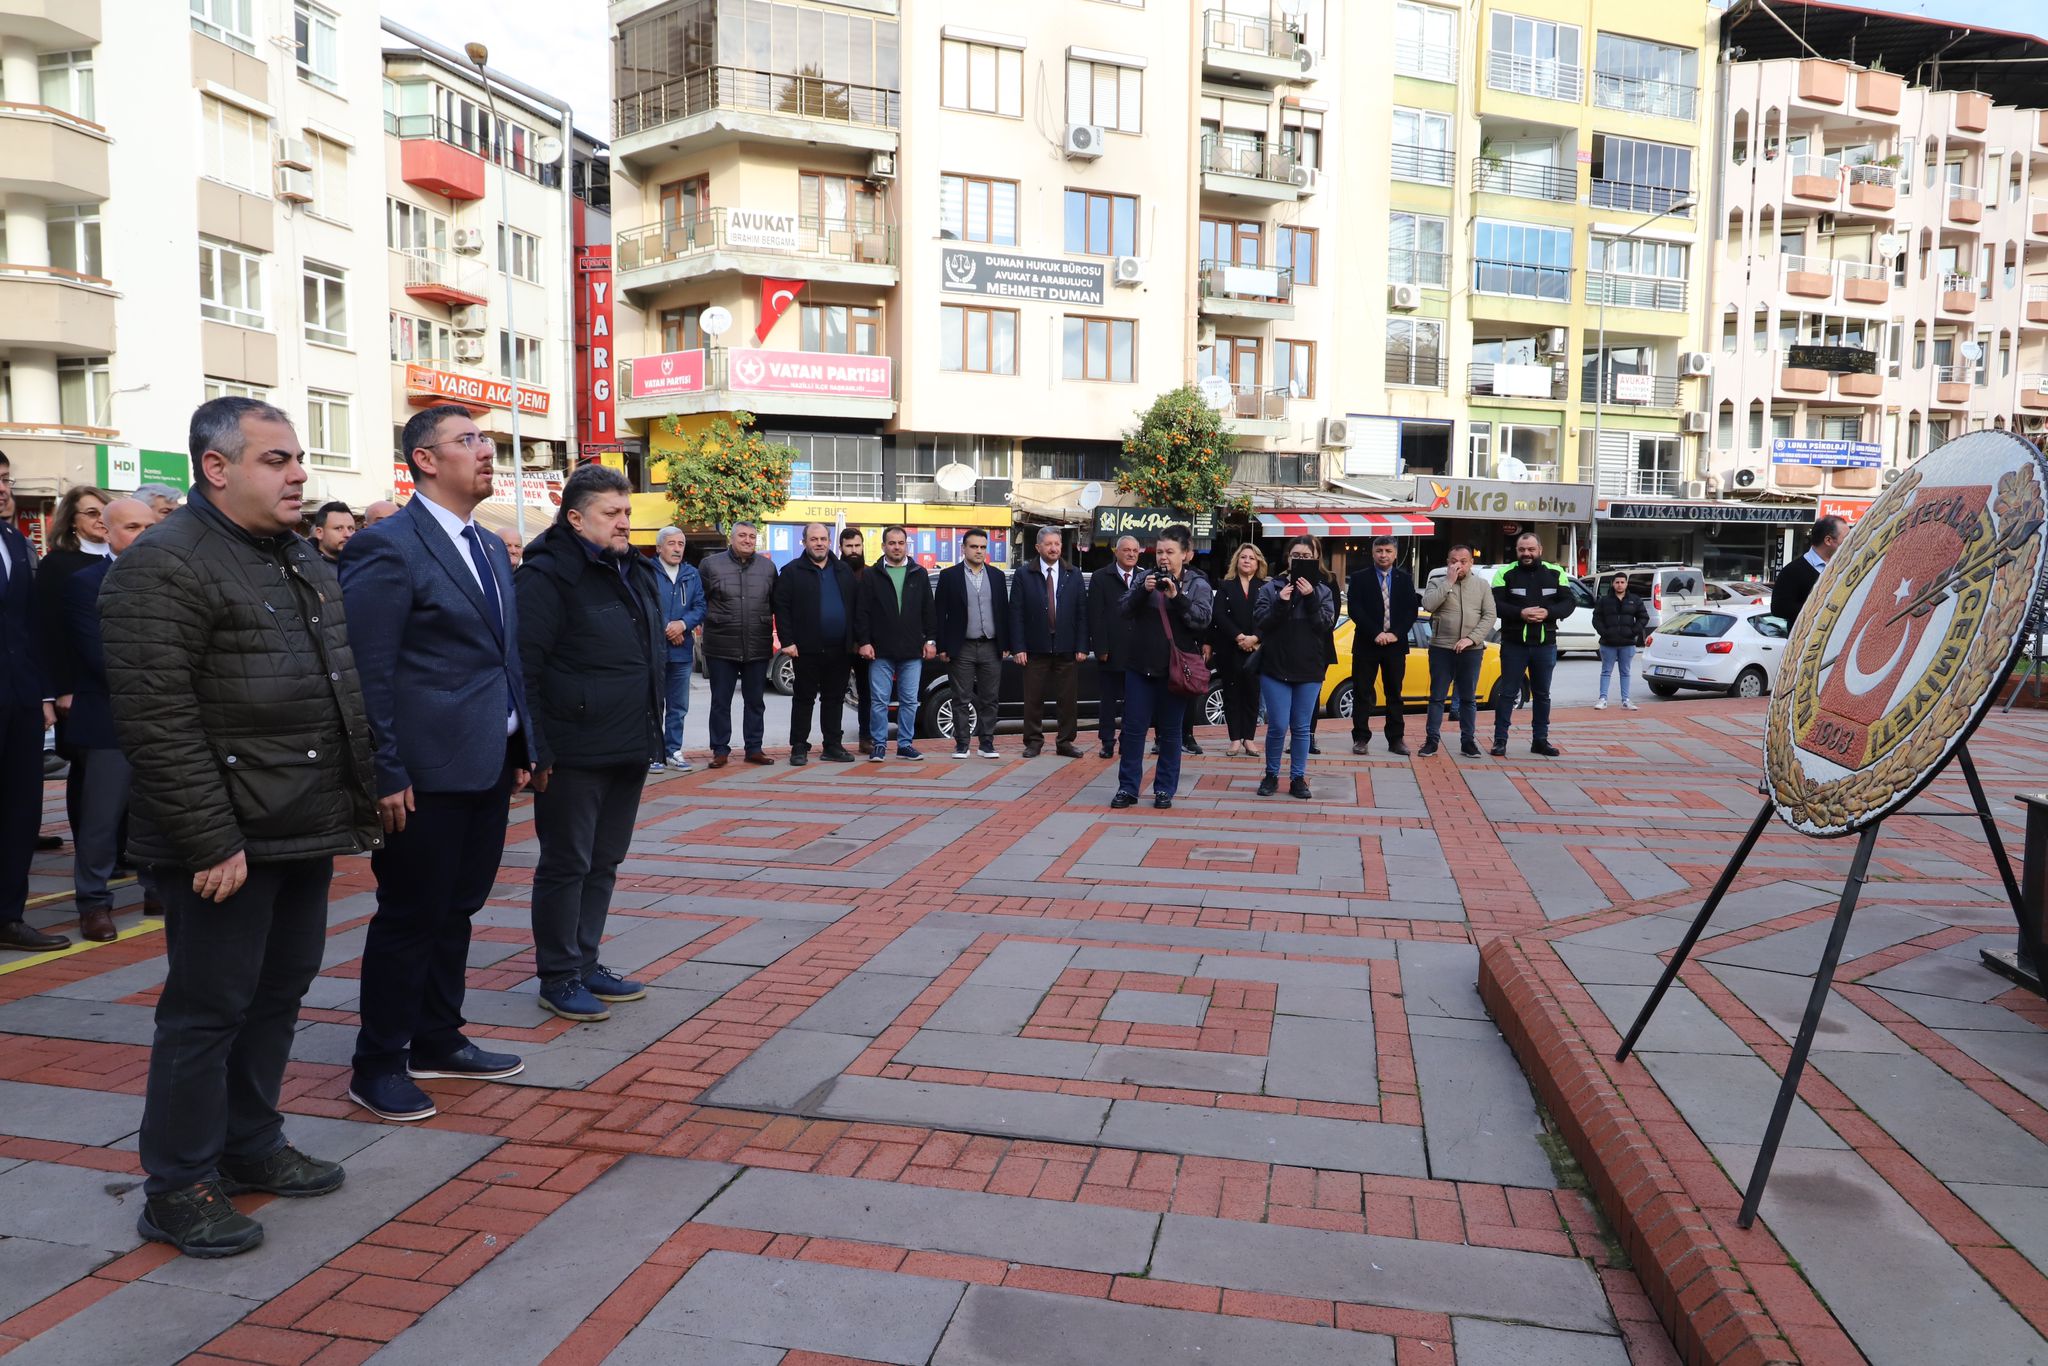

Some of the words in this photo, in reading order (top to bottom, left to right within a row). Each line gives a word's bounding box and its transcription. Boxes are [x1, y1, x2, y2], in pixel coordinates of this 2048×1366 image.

[731, 211, 794, 233] AVUKAT
[761, 235, 796, 247] BERGAMA
[985, 256, 1024, 269] DUMAN
[1026, 261, 1061, 273] HUKUK
[1062, 262, 1101, 276] BÜROSU
[995, 270, 1031, 282] AVUKAT
[1031, 274, 1040, 283] &
[1040, 275, 1093, 288] ARABULUCU
[986, 282, 1047, 296] MEHMET
[1048, 287, 1101, 303] DUMAN
[592, 282, 610, 432] YARGI
[769, 362, 823, 380] VATAN
[826, 365, 886, 383] PARTİSİ
[438, 374, 484, 399] YARGI
[644, 376, 666, 389] VATAN
[1787, 442, 1808, 450] LUNA
[113, 460, 135, 472] HDI
[498, 480, 545, 490] LAHACUN
[1456, 485, 1509, 512] ikra
[1513, 496, 1577, 517] mobilya
[805, 506, 822, 516] JET
[1623, 504, 1686, 519] AVUKAT
[1688, 506, 1744, 521] ORKUN
[1745, 508, 1803, 522] KIZMAZ
[1813, 719, 1854, 755] 1993
